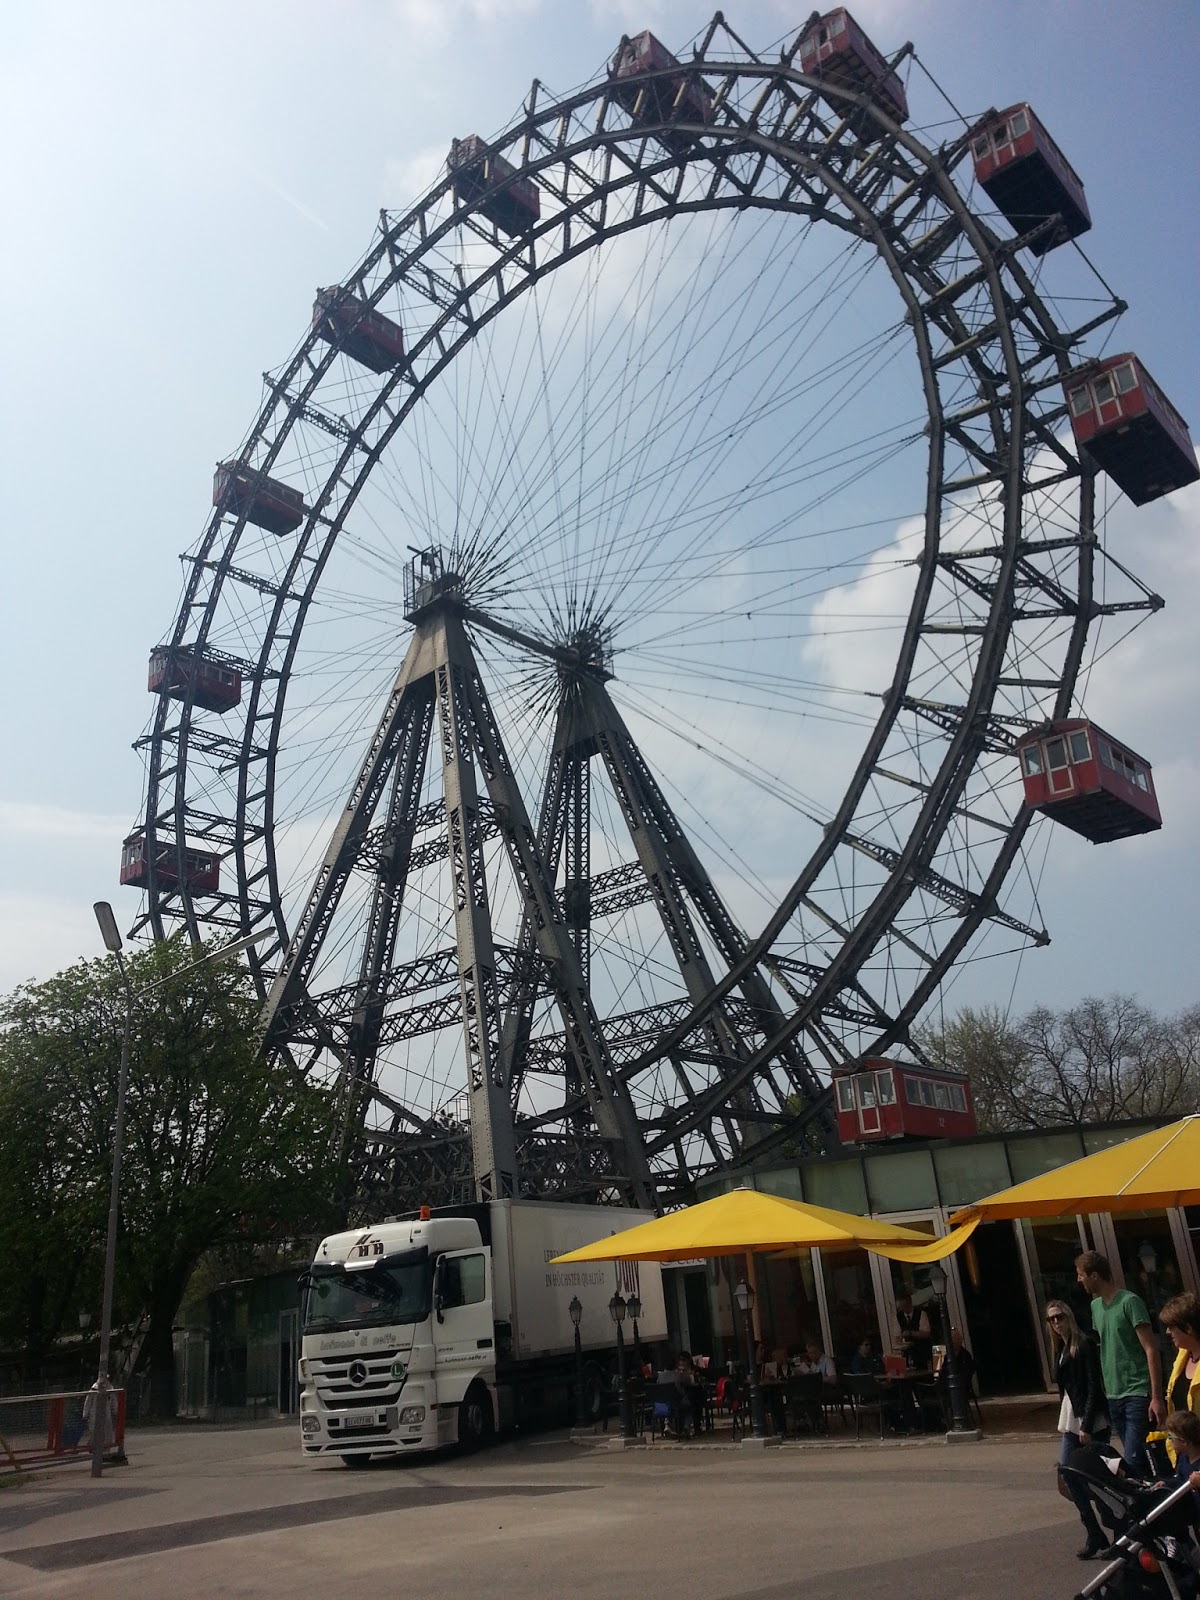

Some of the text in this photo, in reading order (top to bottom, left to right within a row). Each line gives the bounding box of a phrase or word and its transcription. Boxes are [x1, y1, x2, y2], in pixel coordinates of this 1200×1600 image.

[545, 1274, 552, 1287] IN
[552, 1271, 581, 1287] HÖCHSTER
[582, 1270, 605, 1287] QUALITÄT
